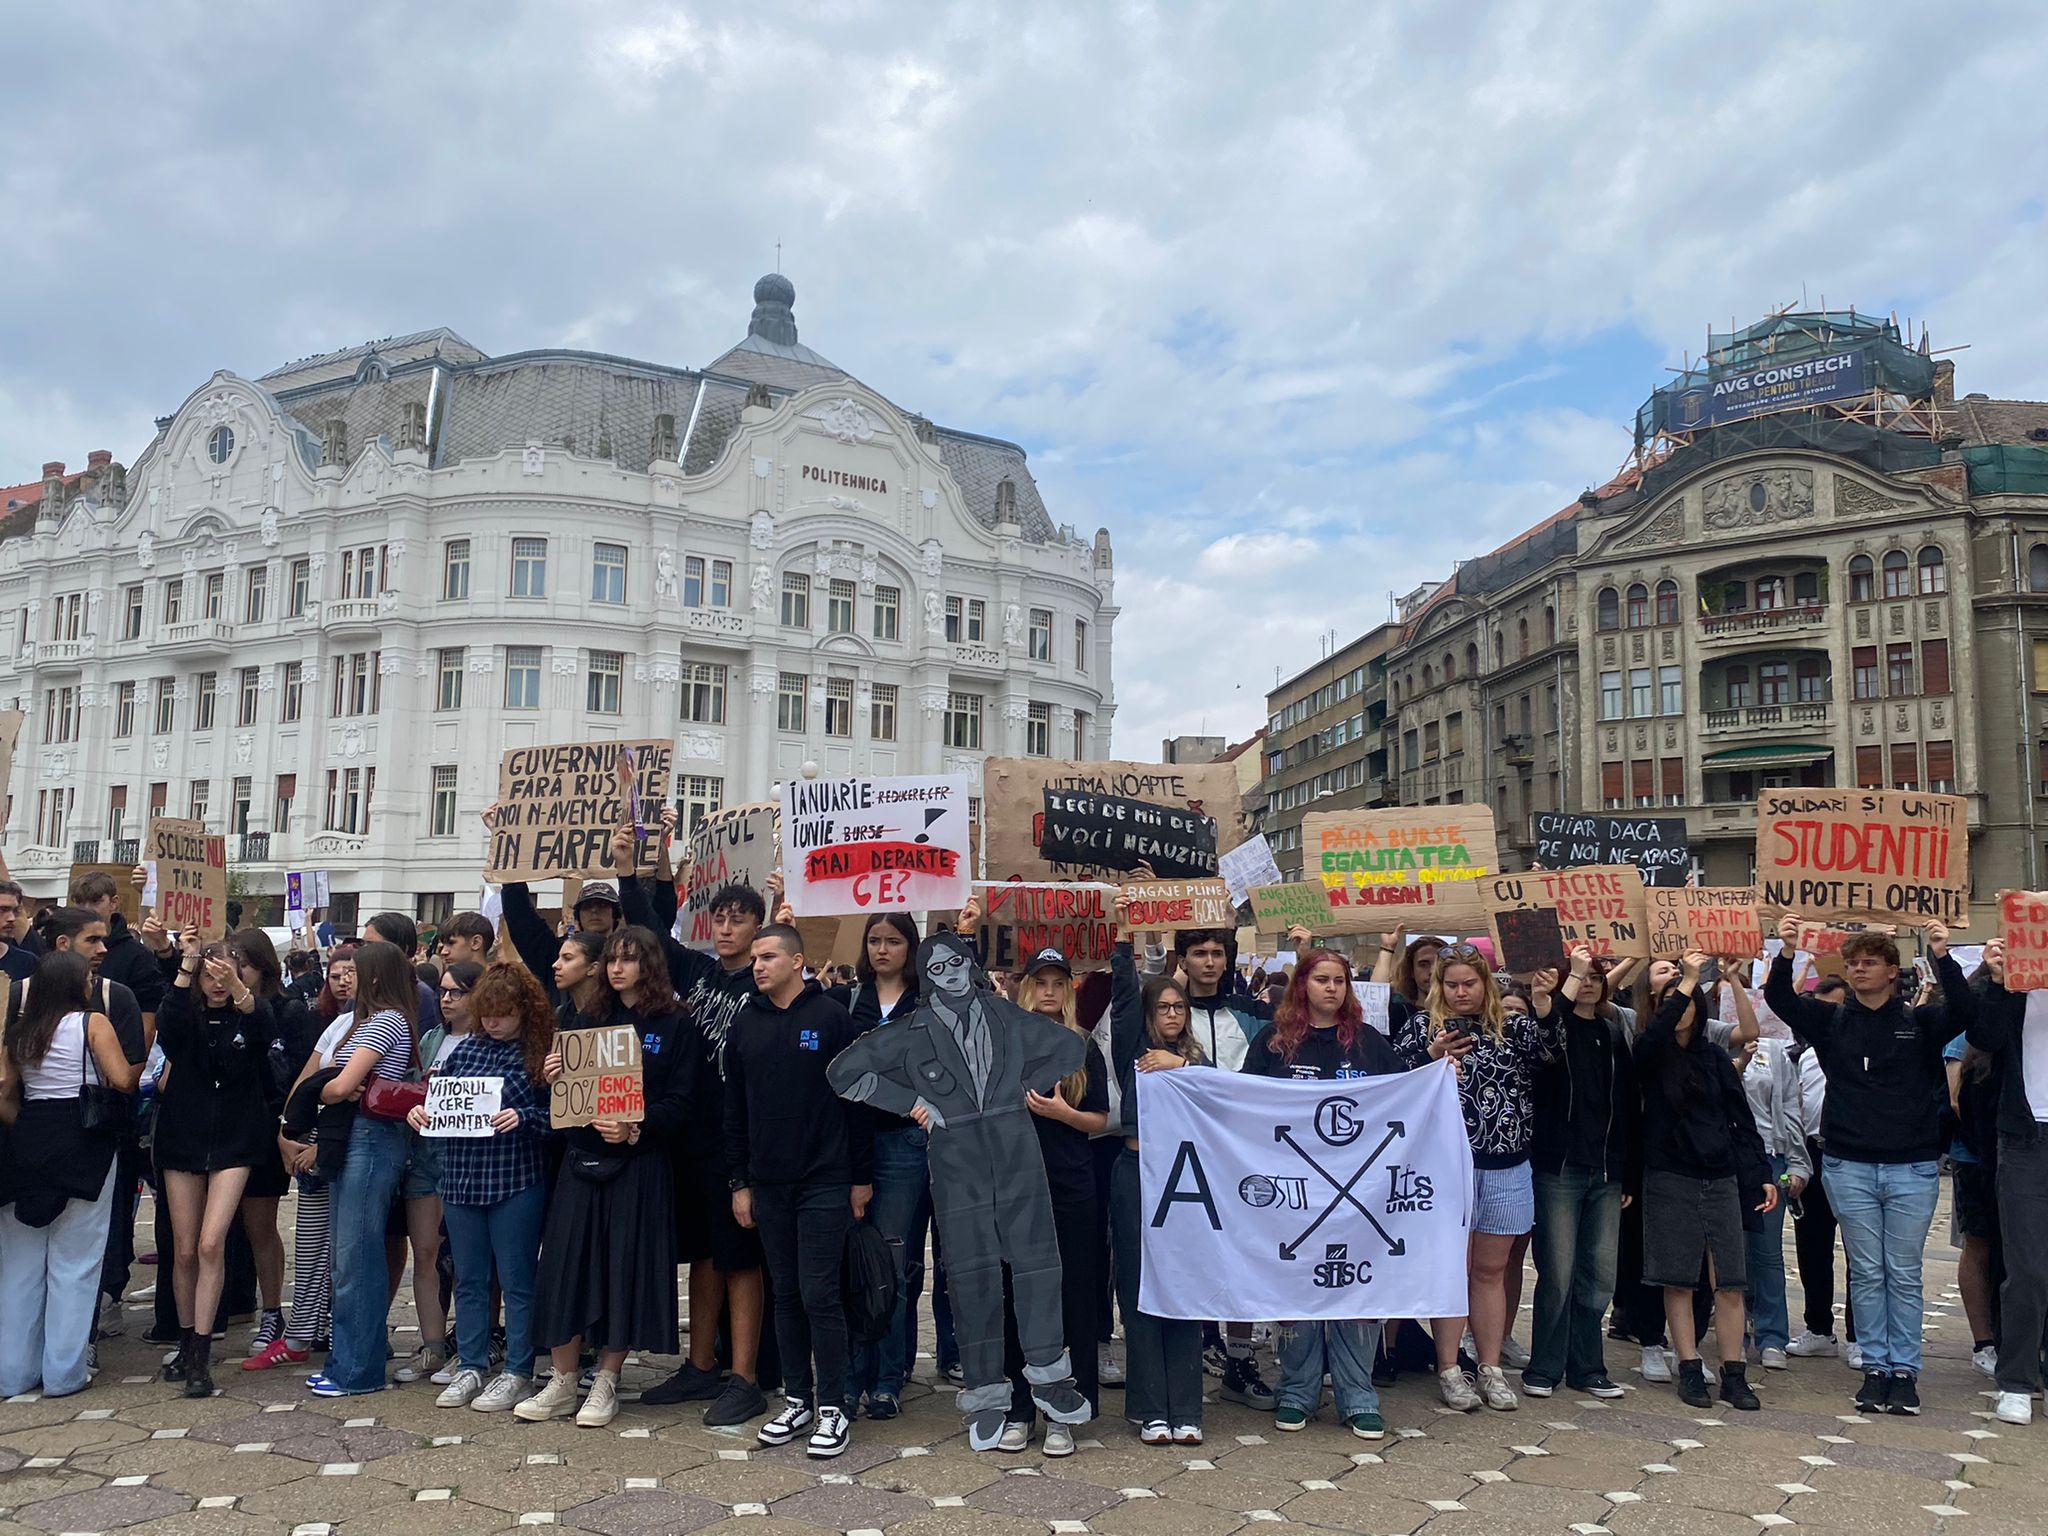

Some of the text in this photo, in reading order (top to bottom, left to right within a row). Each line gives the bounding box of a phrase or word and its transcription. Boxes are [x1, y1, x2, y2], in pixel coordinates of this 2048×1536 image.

[1713, 354, 1852, 397] AVG CONSTECH
[1758, 380, 1796, 399] PENTRU
[802, 464, 887, 495] POLITEHNICA
[508, 743, 625, 777] GUVERNU
[494, 802, 521, 828] NOI
[527, 798, 597, 826] N-AVEM
[1102, 803, 1127, 821] DE
[1169, 815, 1195, 834] DE
[692, 818, 755, 863] STATUL
[843, 825, 885, 842] BURSE
[1321, 825, 1381, 850] FĂRĂ
[1609, 818, 1662, 842] DACĂ
[205, 837, 226, 869] NU
[493, 829, 662, 870] ÎN FARFUIE
[810, 848, 950, 877] MAI DEPARTE
[1539, 839, 1563, 858] PE
[192, 870, 203, 890] DE
[852, 870, 912, 907] CE?
[1127, 884, 1181, 900] BAGAJE
[1493, 872, 1626, 902] CU TĂCERE
[1764, 880, 1794, 906] NU
[1800, 879, 1844, 907] POT
[986, 885, 1107, 921] VIITORUL
[1128, 899, 1193, 925] BURSE
[1555, 898, 1629, 922] REFUZ
[1655, 889, 1677, 907] CE
[1609, 920, 1637, 941] ÎN
[2007, 927, 2048, 950] NU
[596, 1028, 638, 1068] NET
[438, 1096, 475, 1112] CERE
[553, 1079, 596, 1118] 90%
[1150, 1141, 1224, 1231] A
[1385, 1199, 1434, 1214] UMC
